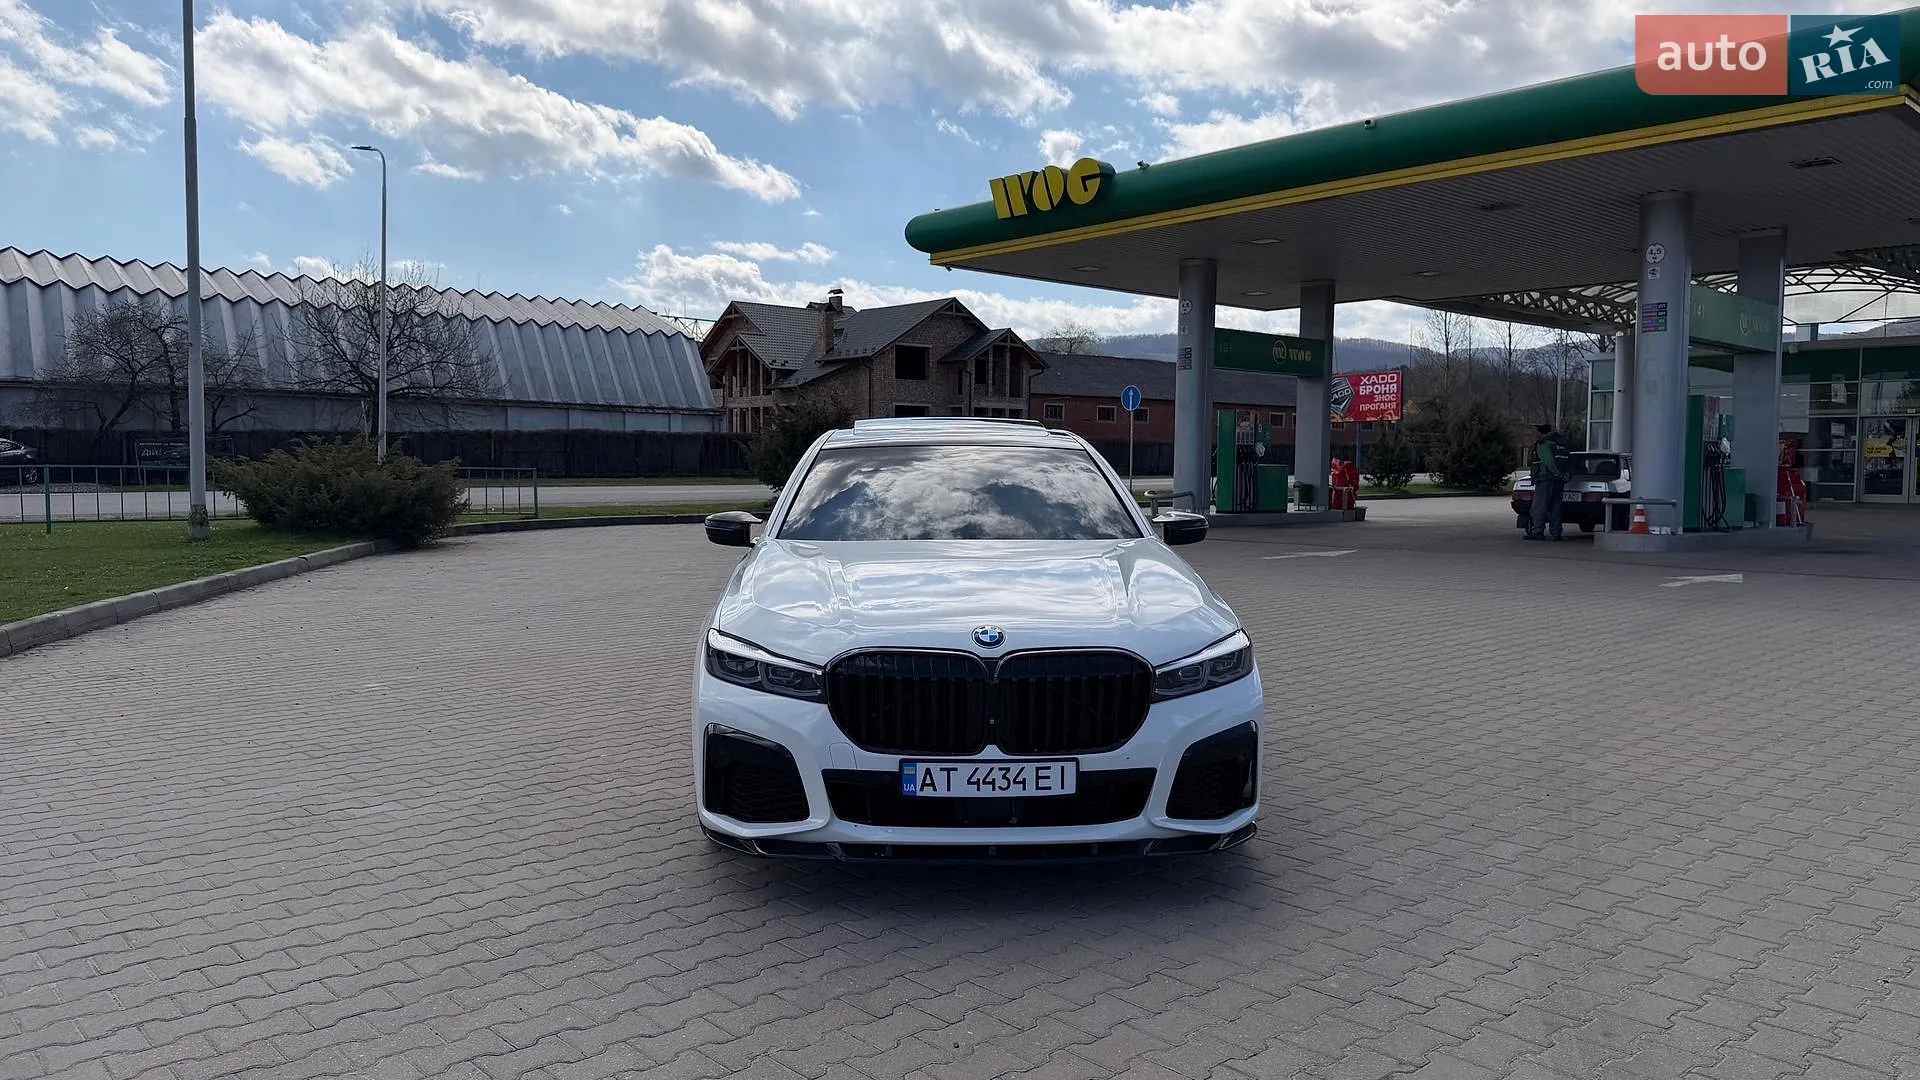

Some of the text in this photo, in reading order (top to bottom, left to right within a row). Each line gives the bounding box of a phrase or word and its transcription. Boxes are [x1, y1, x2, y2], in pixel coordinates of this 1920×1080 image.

[989, 157, 1101, 219] WOG
[1359, 383, 1397, 395] БРОНЯ
[1374, 394, 1397, 402] ЗНОС
[1360, 402, 1397, 411] ПРОГАНЯ
[903, 765, 1065, 792] UA AT 4434 EI
